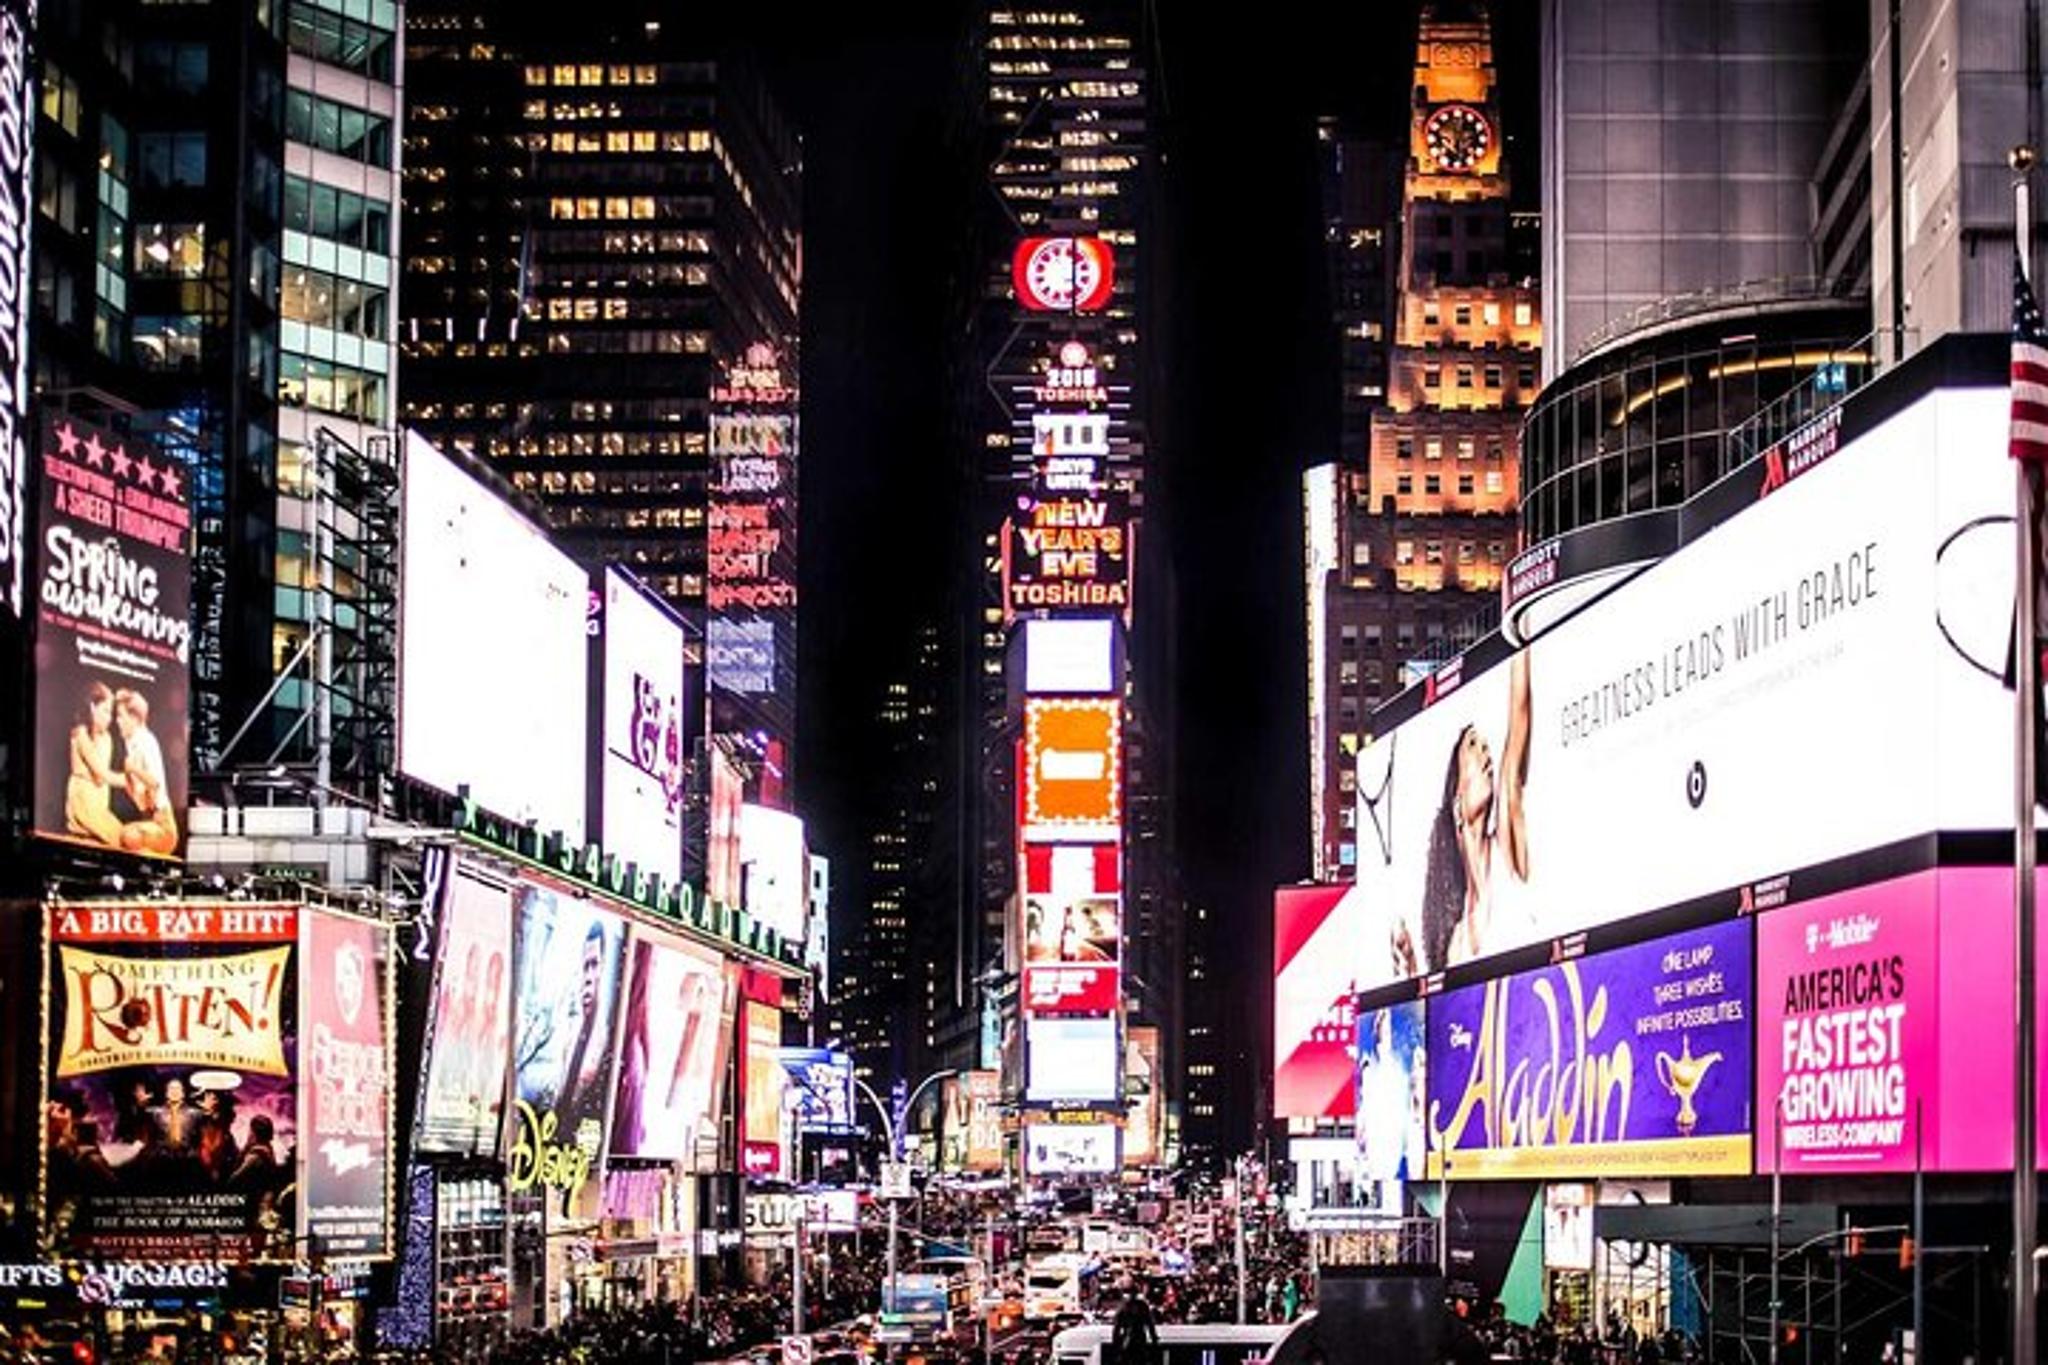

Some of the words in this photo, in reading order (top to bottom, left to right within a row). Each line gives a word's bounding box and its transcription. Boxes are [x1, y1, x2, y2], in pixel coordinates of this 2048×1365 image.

[1034, 387, 1107, 401] TOSHIBA
[1035, 503, 1107, 527] NEW
[1019, 528, 1122, 552] YEAR'S
[47, 525, 159, 605] SPRING
[1043, 552, 1098, 576] EVE
[1011, 583, 1126, 604] TOSHIBA
[42, 577, 193, 664] awakening
[1562, 661, 1657, 748] GREATNESS
[1663, 624, 1725, 698] LEADS
[1733, 590, 1789, 661] WITH
[1797, 541, 1878, 630] GRACE
[158, 909, 208, 934] FAT
[93, 959, 256, 979] SOMETHING
[1784, 955, 1905, 1015] AMERICA'S
[1781, 1003, 1907, 1073] FASTEST
[1430, 961, 1635, 1151] Aladdin
[1780, 1063, 1907, 1121] GROWING
[508, 1098, 591, 1219] Disney
[187, 1194, 247, 1207] ALADDIN
[93, 1216, 119, 1228] THE
[124, 1216, 161, 1228] BOOK
[163, 1216, 183, 1228] OF
[185, 1216, 246, 1228] MORMON
